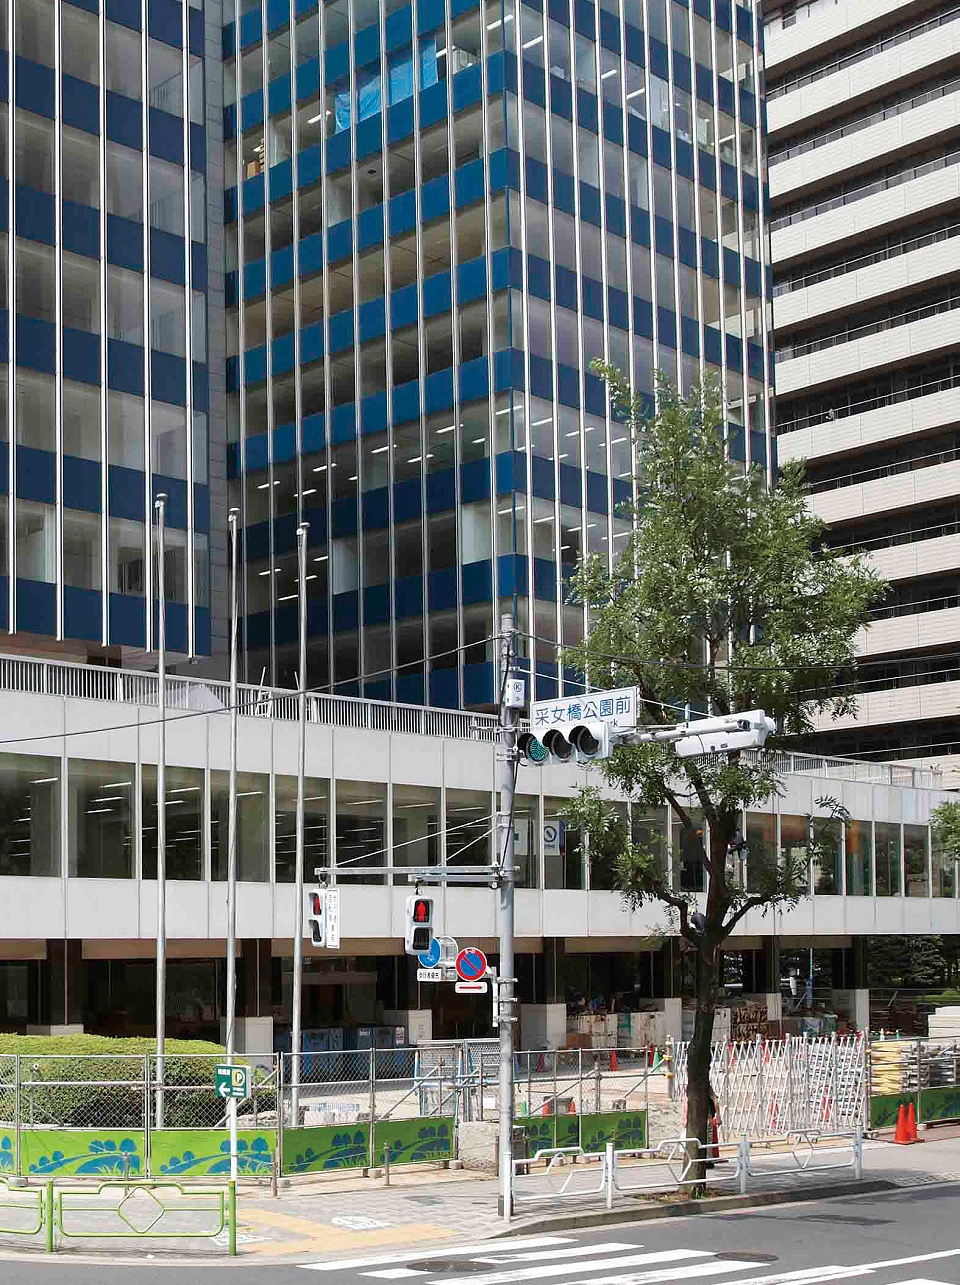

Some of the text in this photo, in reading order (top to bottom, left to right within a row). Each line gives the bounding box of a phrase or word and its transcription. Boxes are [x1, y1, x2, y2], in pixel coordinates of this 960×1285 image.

[535, 696, 631, 726] 采女橋公園前
